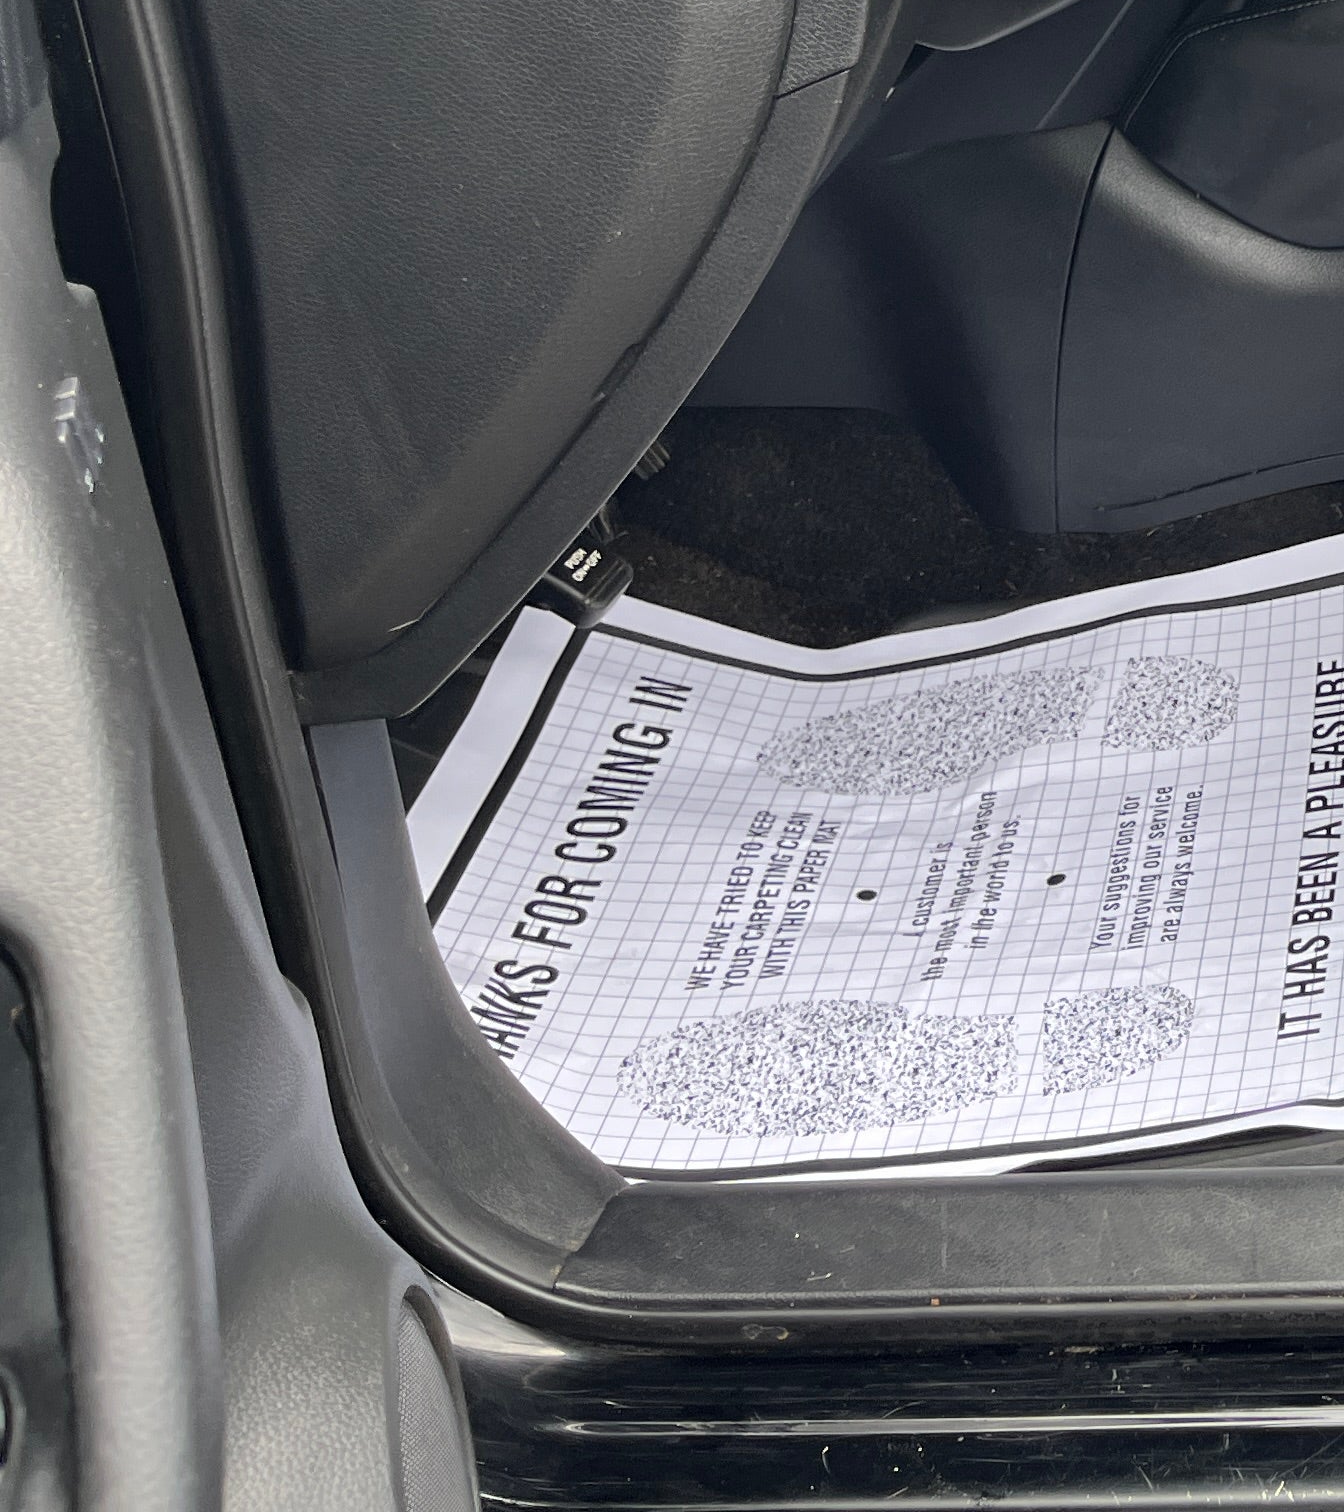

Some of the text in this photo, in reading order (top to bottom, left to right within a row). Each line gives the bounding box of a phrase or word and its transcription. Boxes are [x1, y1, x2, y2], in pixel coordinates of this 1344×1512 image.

[629, 676, 692, 712] IN
[555, 723, 673, 863] COMING
[929, 841, 954, 855] is
[1302, 820, 1342, 839] A
[511, 875, 602, 949] FOR
[685, 810, 777, 990] WE HAVE TRIED TO KEEP
[720, 812, 813, 990] YOUR CARPETING CLEAN
[758, 819, 842, 979] WITH THIS PAPER MAT
[912, 858, 947, 927] customer
[920, 791, 998, 982] the most important person
[964, 814, 1022, 949] in the world to us.
[1089, 796, 1141, 951] Your suggestions for
[1121, 786, 1173, 951] improving our service
[1160, 784, 1204, 943] are always welcome.
[1292, 851, 1339, 925] BEEN
[1277, 1012, 1322, 1040] IT
[1282, 935, 1331, 1000] HAS
